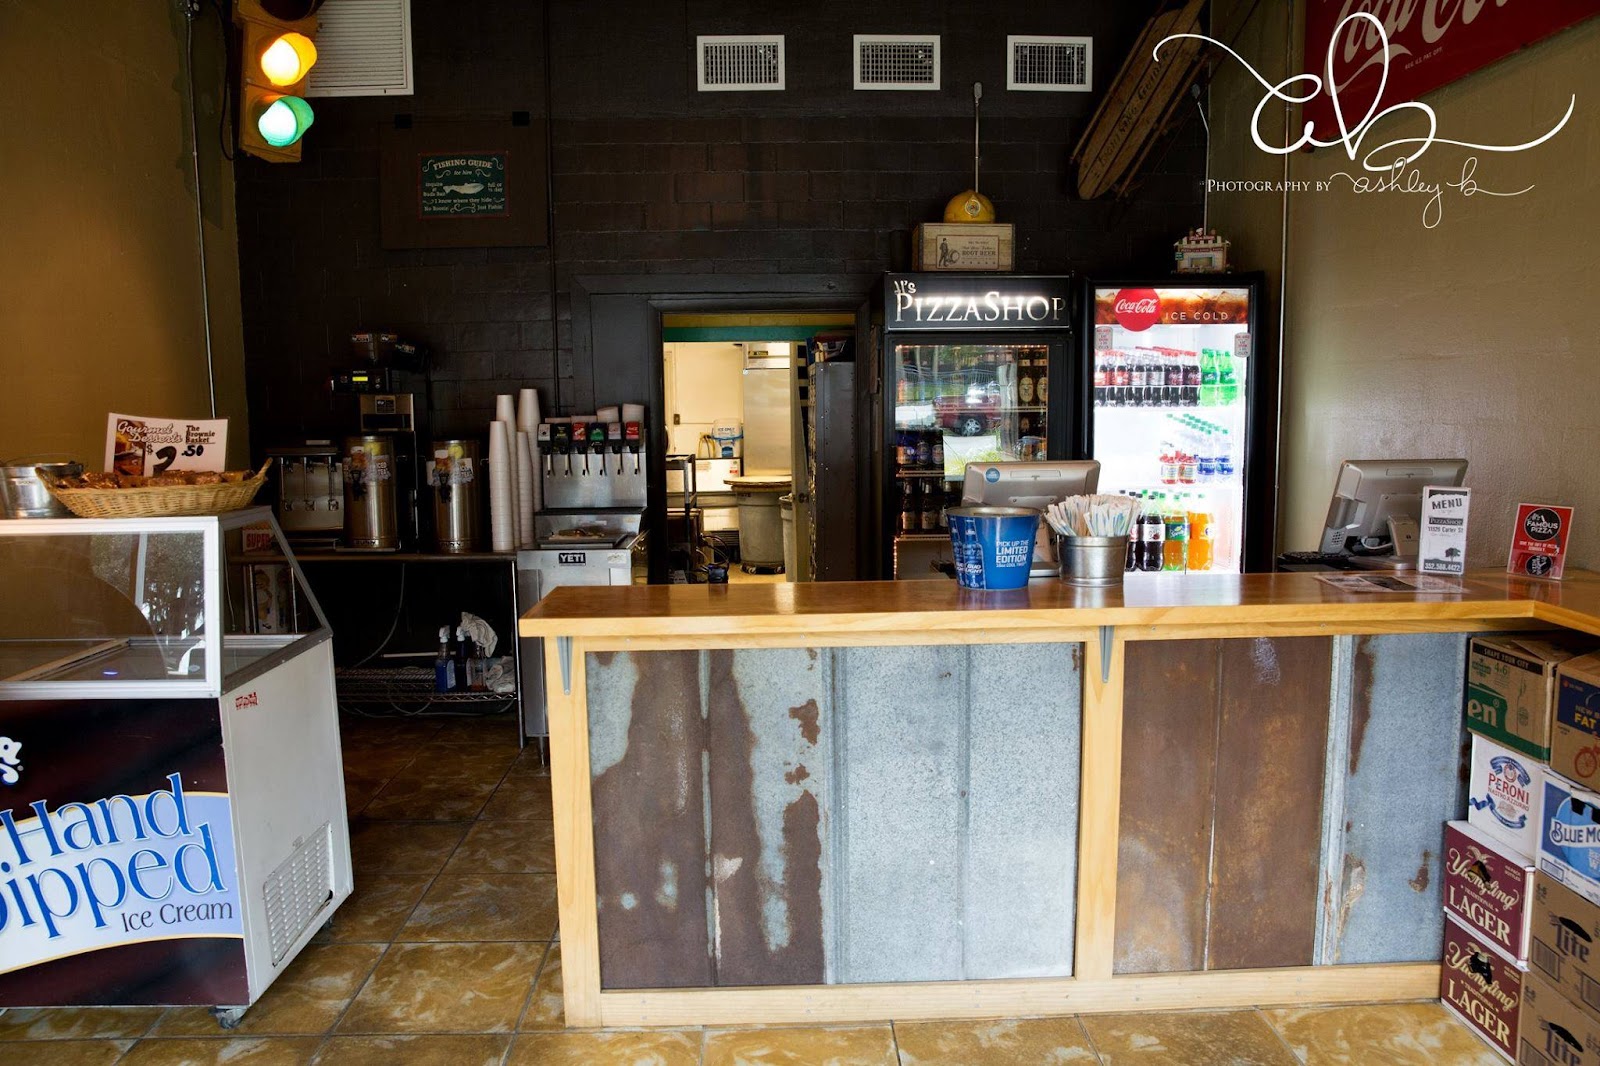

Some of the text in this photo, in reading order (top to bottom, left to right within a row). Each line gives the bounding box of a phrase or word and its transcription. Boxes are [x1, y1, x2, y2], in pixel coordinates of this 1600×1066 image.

[433, 159, 493, 171] FISHING GUIDE
[1115, 298, 1159, 314] Coca-Cola
[1165, 311, 1229, 321] ICE COLD
[117, 420, 174, 436] Gourmet
[186, 424, 201, 432] The
[128, 432, 183, 444] Desserts
[1432, 498, 1463, 510] MENU
[1526, 519, 1559, 530] FAMOUS
[996, 546, 1029, 555] LIMITED
[560, 553, 585, 564] YETI
[996, 554, 1027, 564] EDITION
[1574, 712, 1597, 730] FAT
[1488, 773, 1530, 805] PERONI
[0, 771, 195, 867] Hand
[121, 899, 234, 933] Ice Cream
[1449, 885, 1511, 946] LAGER
[1447, 978, 1511, 1049] LAGER
